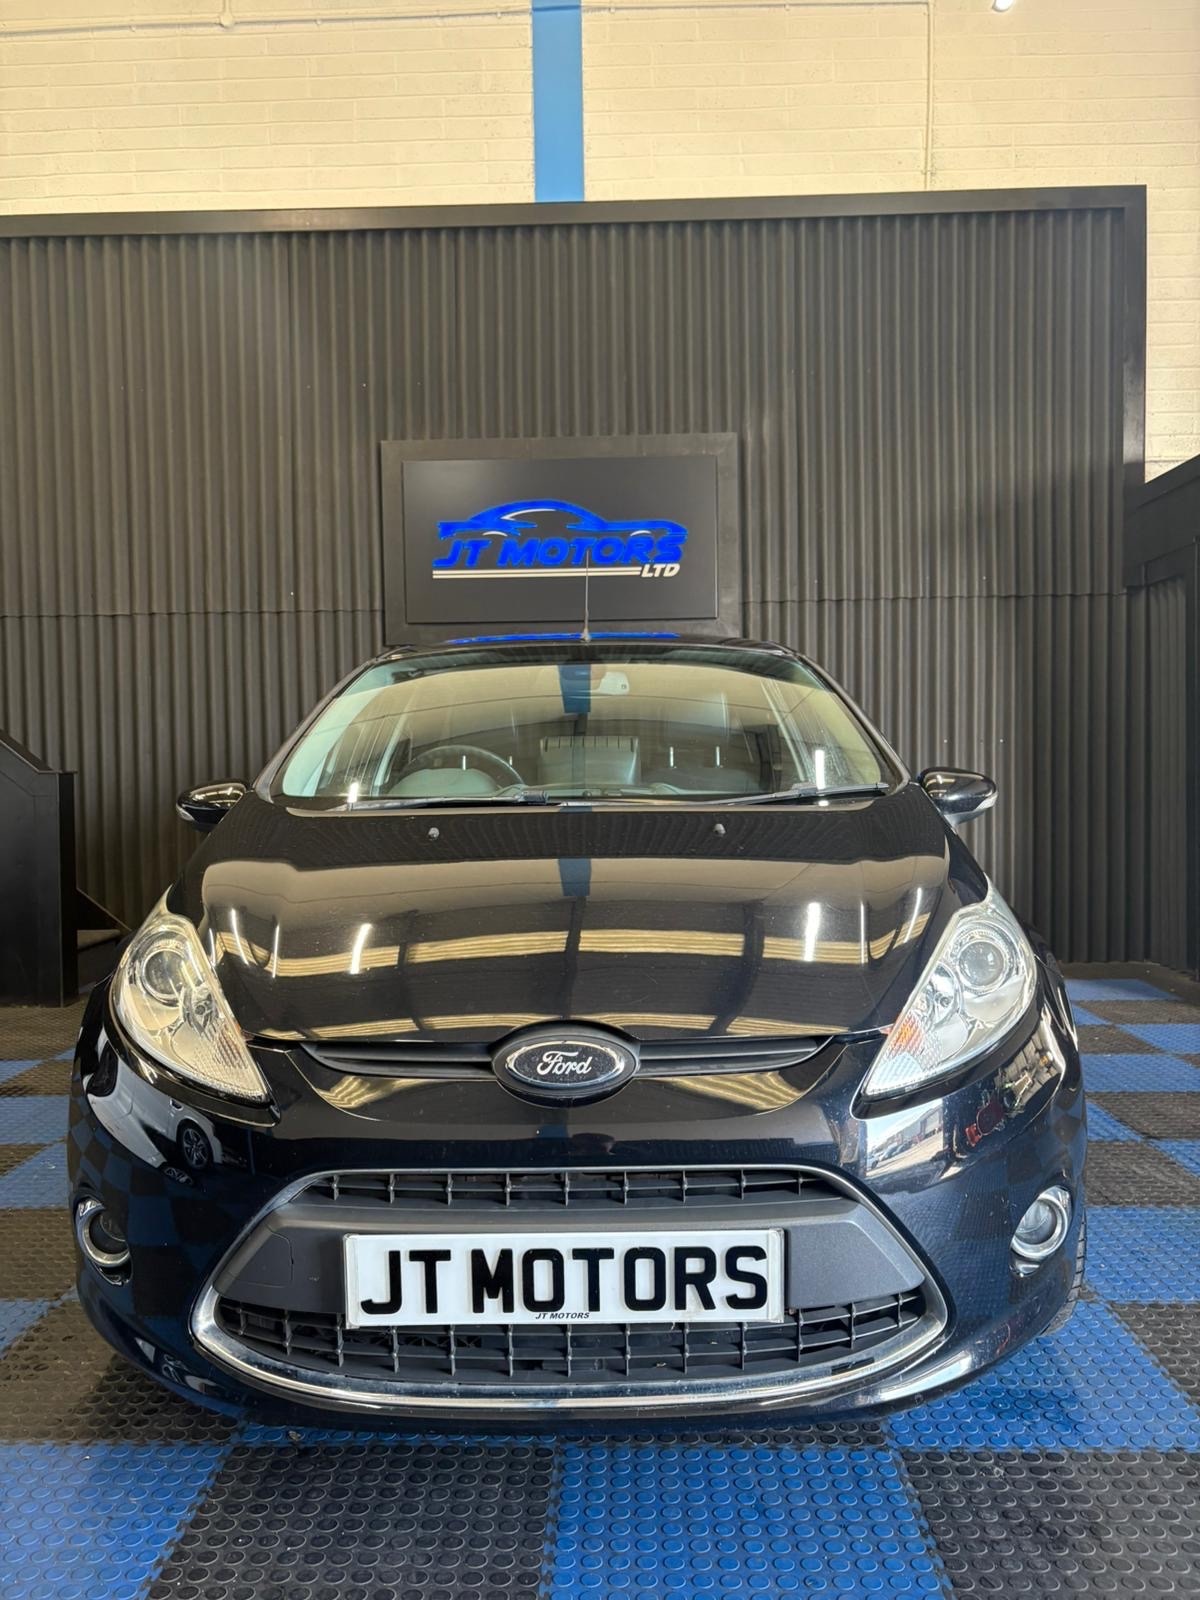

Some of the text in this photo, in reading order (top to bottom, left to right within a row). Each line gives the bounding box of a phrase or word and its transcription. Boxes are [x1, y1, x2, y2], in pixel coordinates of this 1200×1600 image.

[432, 534, 688, 567] JT MOTORS
[641, 563, 681, 578] LTD
[536, 1050, 593, 1075] Ford
[360, 1245, 768, 1315] JT MOTORS
[535, 1312, 590, 1320] JT MOTORS
